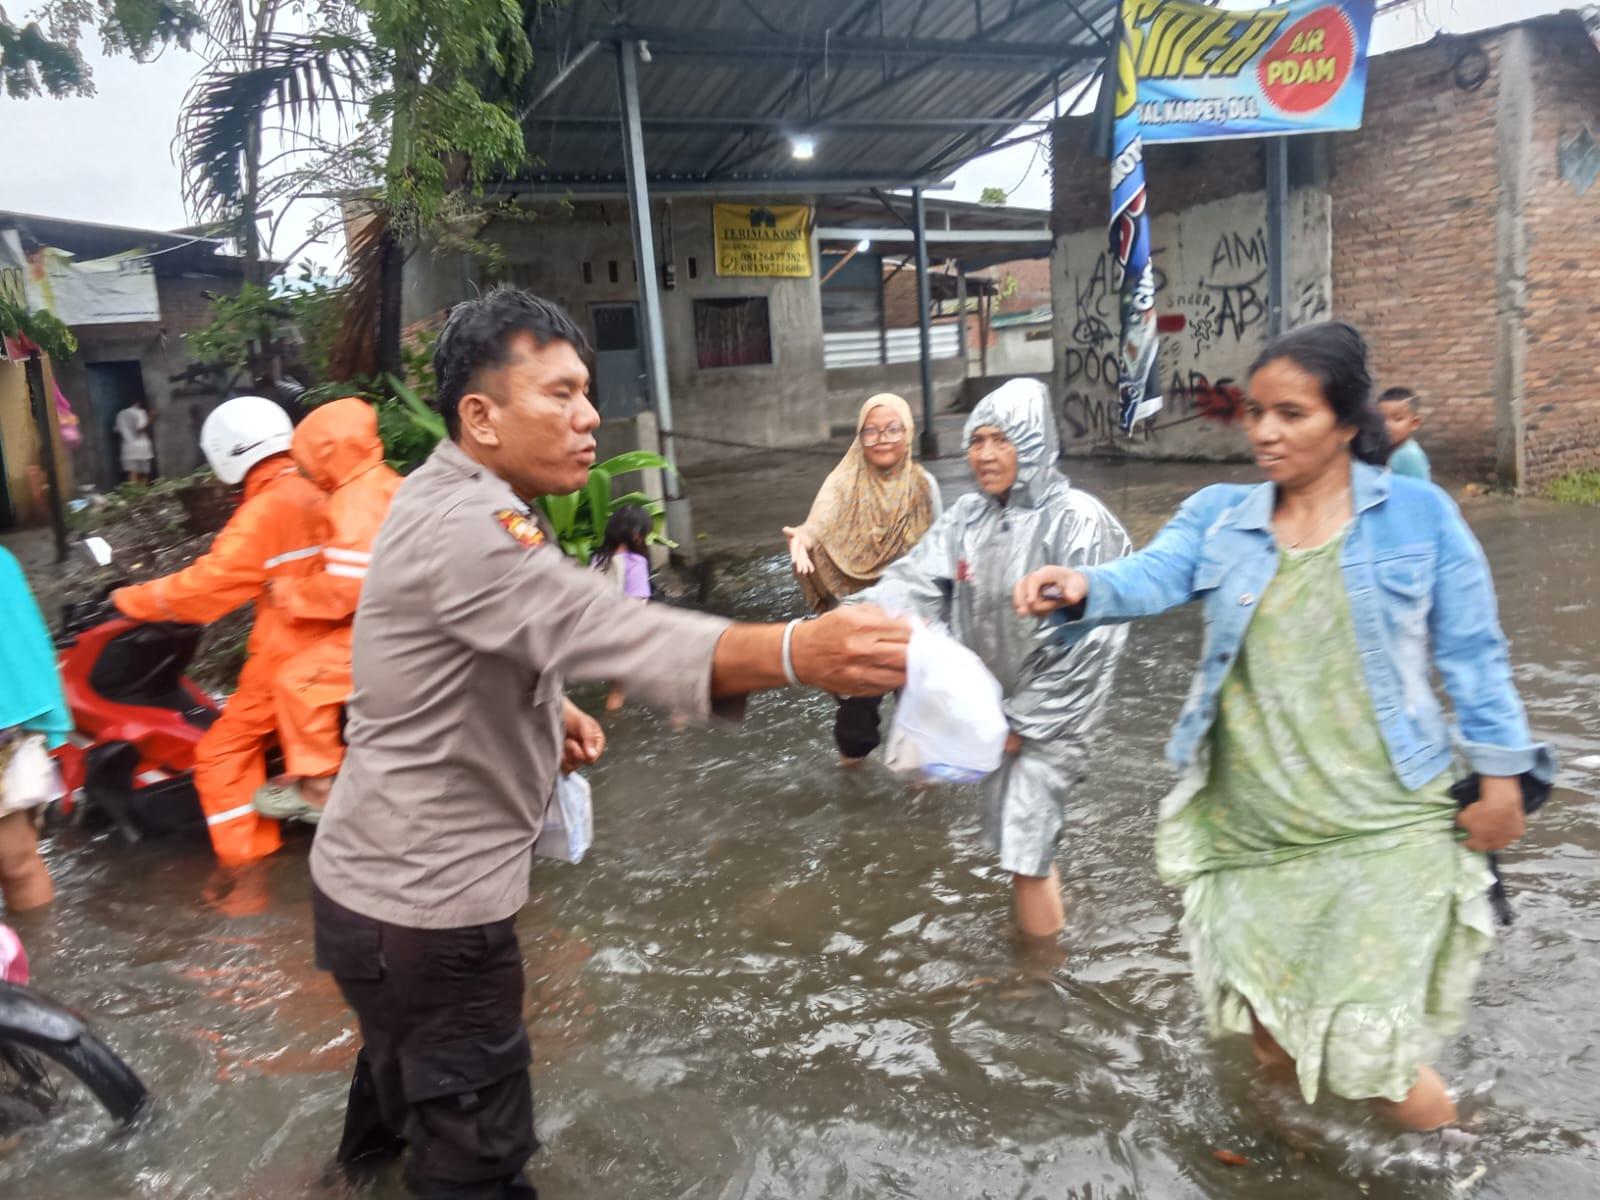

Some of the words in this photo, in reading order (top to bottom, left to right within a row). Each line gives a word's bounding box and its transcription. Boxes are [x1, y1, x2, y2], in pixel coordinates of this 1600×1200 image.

[1288, 29, 1326, 54] AIR
[1266, 57, 1337, 87] PDAM
[1228, 96, 1260, 120] DLL
